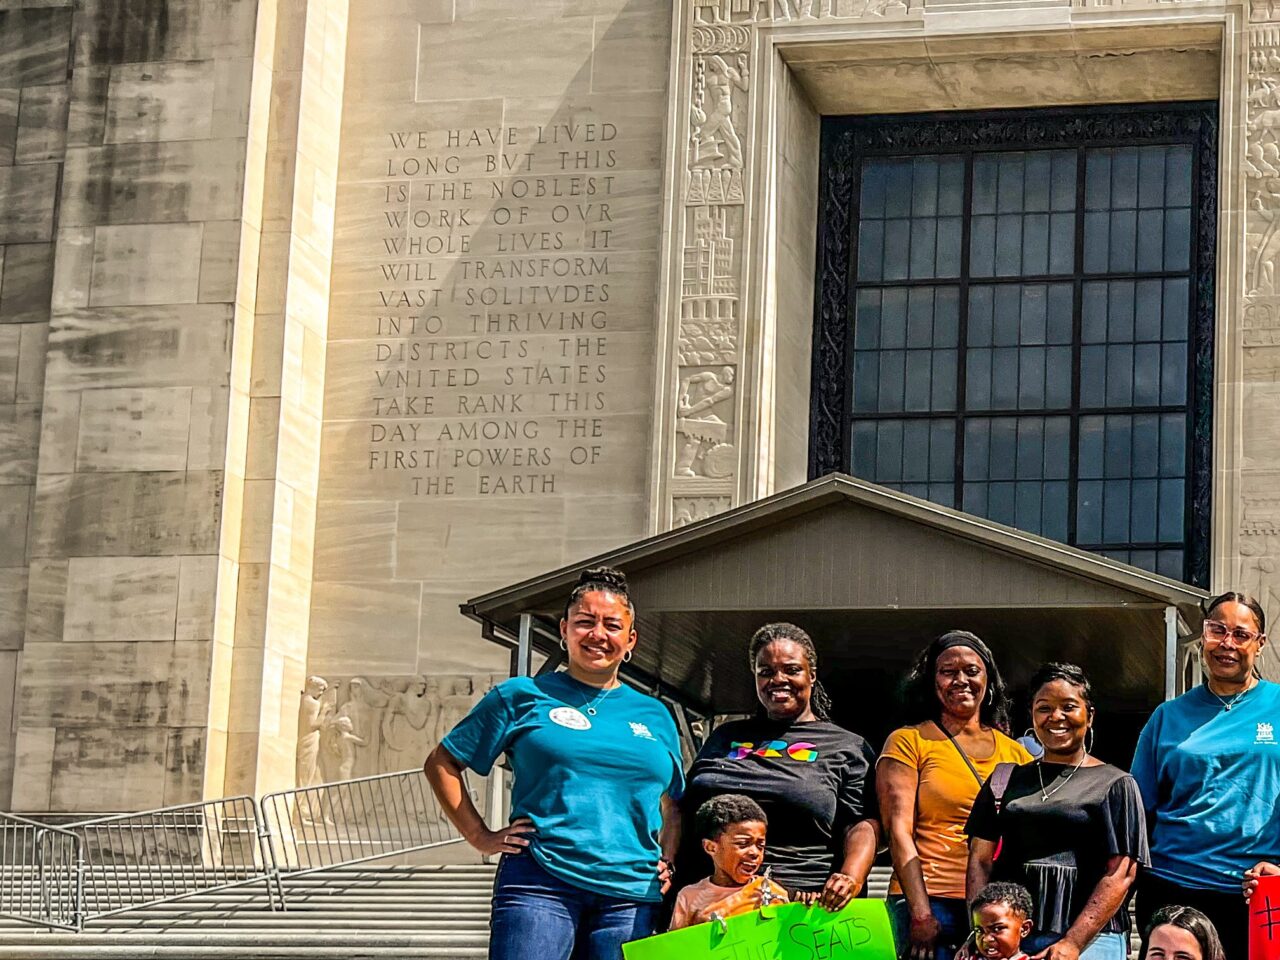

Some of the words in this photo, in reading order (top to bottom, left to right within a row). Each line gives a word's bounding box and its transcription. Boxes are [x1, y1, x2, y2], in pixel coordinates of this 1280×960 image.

[390, 131, 428, 149] WE
[447, 127, 518, 148] HAVE
[537, 123, 618, 145] LIVED
[387, 156, 460, 177] LONG
[486, 154, 535, 172] BVT
[559, 149, 617, 169] THIS
[385, 184, 407, 202] IS
[425, 182, 473, 201] THE
[491, 176, 615, 199] NOBLEST
[385, 208, 471, 229] WORK
[493, 207, 529, 225] OF
[551, 204, 613, 223] OVR
[383, 235, 471, 255] WHOLE
[497, 232, 563, 252] LIVES
[591, 230, 613, 248] IT
[380, 262, 437, 281] WILL
[462, 257, 609, 280] TRANSFORM
[379, 289, 442, 308] VAST
[464, 284, 610, 306] SOLITVDES
[376, 316, 442, 335] INTO
[471, 311, 607, 333] THRIVING
[376, 340, 528, 362] DISTRICTS
[559, 338, 607, 356] THE
[376, 368, 480, 388] VNITED
[504, 365, 607, 385] STATES
[372, 396, 434, 416] TAKE
[458, 394, 523, 414] RANK
[549, 391, 605, 411] THIS
[371, 423, 421, 442] DAY
[438, 420, 539, 441] AMONG
[557, 418, 603, 438] THE
[369, 450, 435, 470] FIRST
[453, 447, 551, 468] POWERS
[570, 445, 603, 465] OF
[412, 476, 454, 495] THE
[479, 475, 556, 494] EARTH
